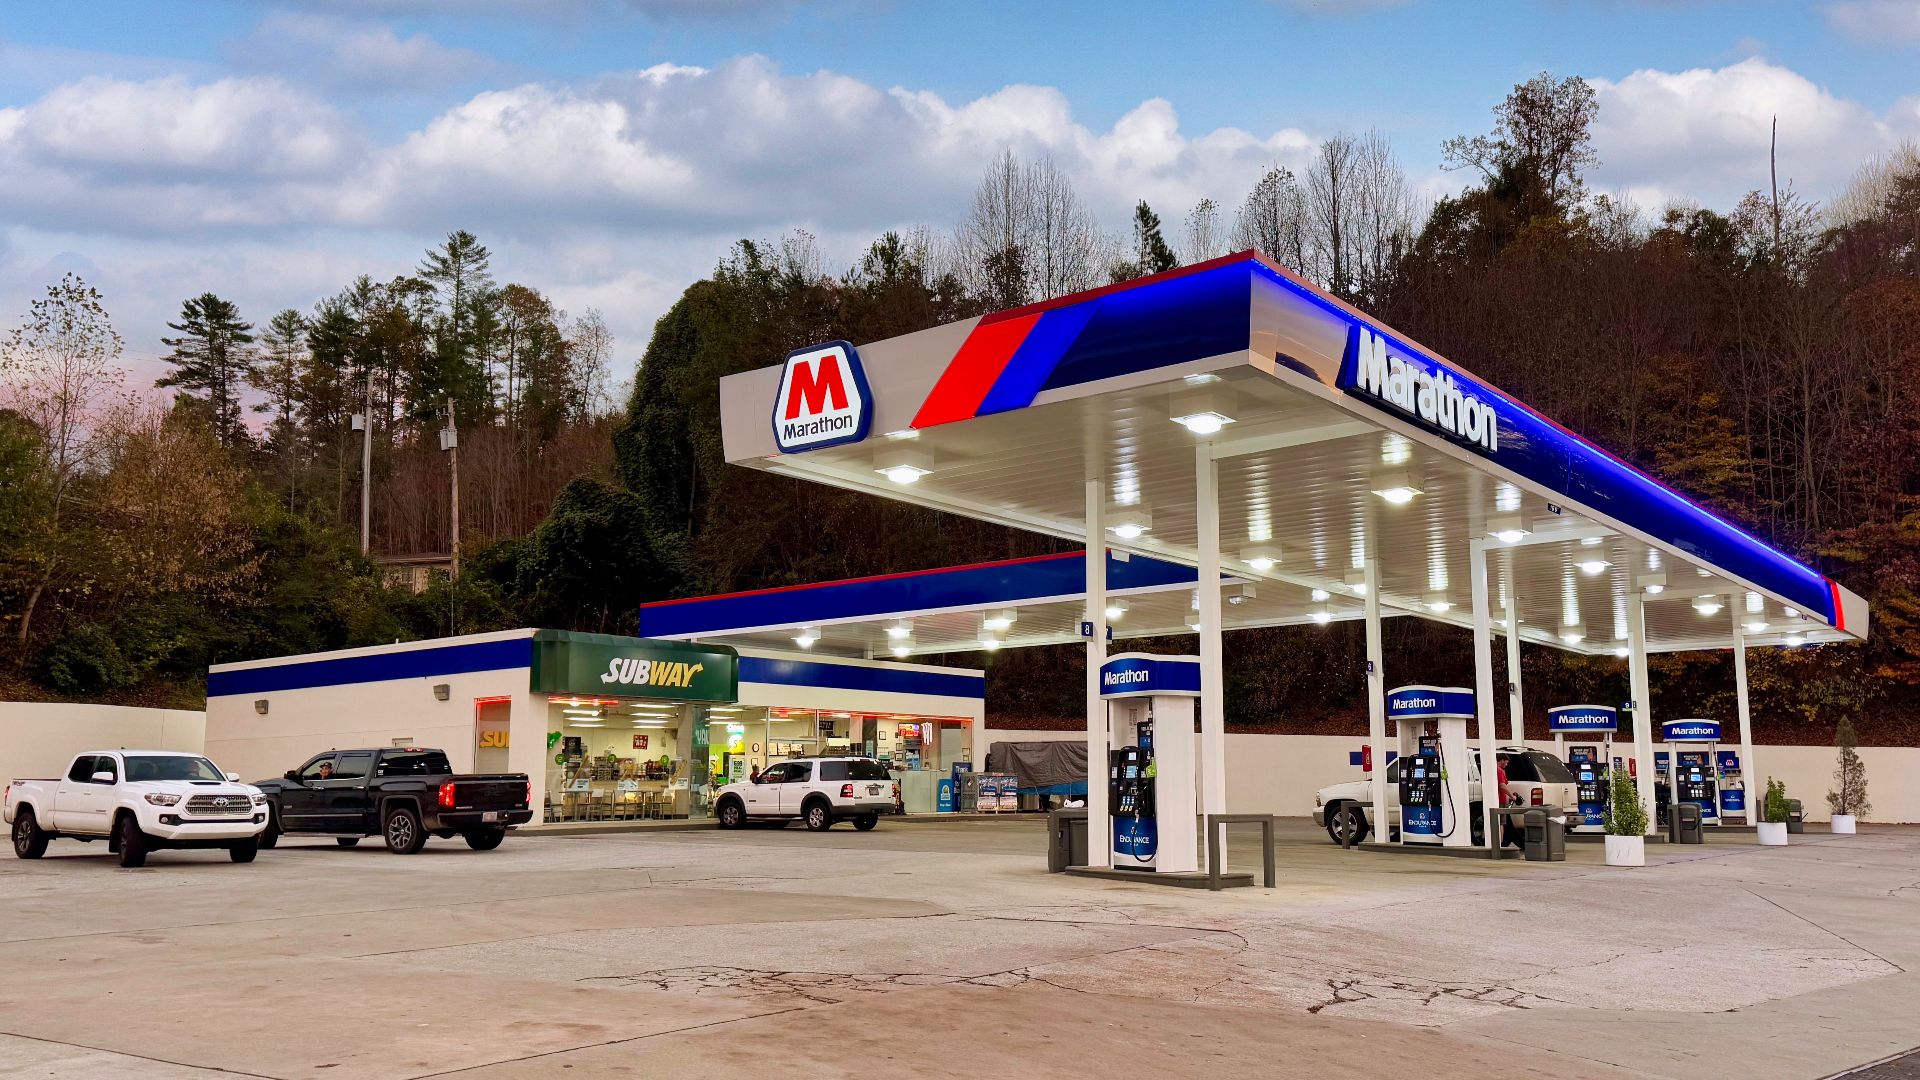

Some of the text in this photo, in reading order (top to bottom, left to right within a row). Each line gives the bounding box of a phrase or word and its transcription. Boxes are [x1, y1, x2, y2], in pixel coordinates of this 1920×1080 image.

[785, 355, 849, 420] M
[1357, 326, 1498, 453] Marathon
[783, 414, 853, 440] Marathon
[1084, 624, 1090, 635] 8
[600, 657, 704, 688] SUBWAY
[1104, 669, 1149, 686] Marathon
[1392, 698, 1436, 710] Marathon
[1558, 714, 1609, 724] Marathon
[1671, 727, 1714, 735] Marathon
